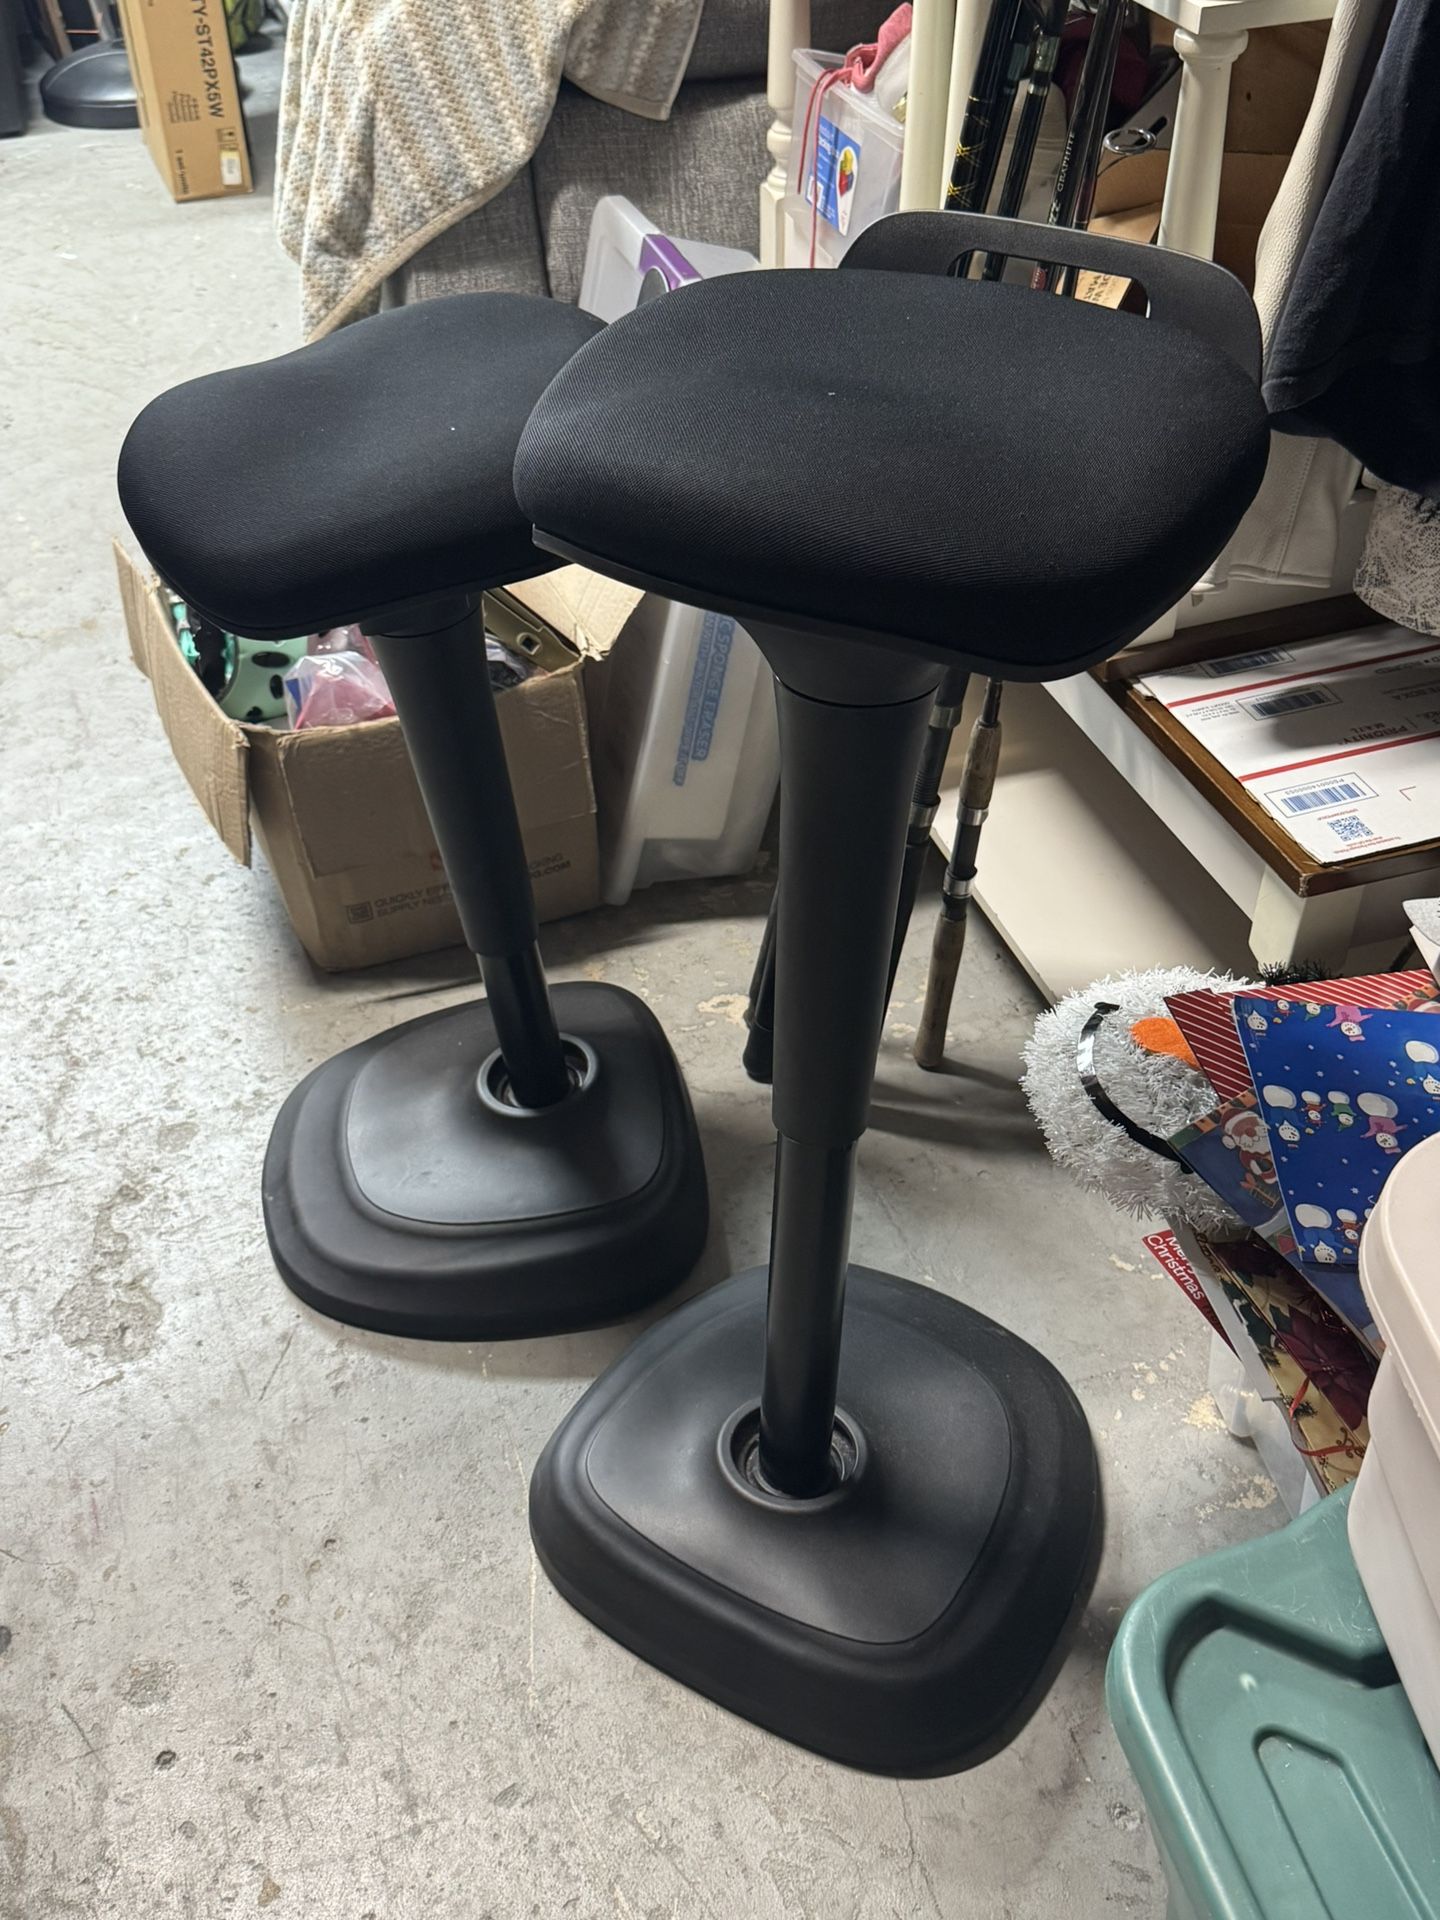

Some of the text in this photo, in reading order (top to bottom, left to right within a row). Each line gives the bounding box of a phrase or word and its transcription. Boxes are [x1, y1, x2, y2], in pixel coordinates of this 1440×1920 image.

[1056, 131, 1075, 193] GRAPHITE
[705, 633, 731, 698] SPONGE
[695, 700, 717, 758] ERASER
[1147, 1235, 1205, 1300] Christmas
